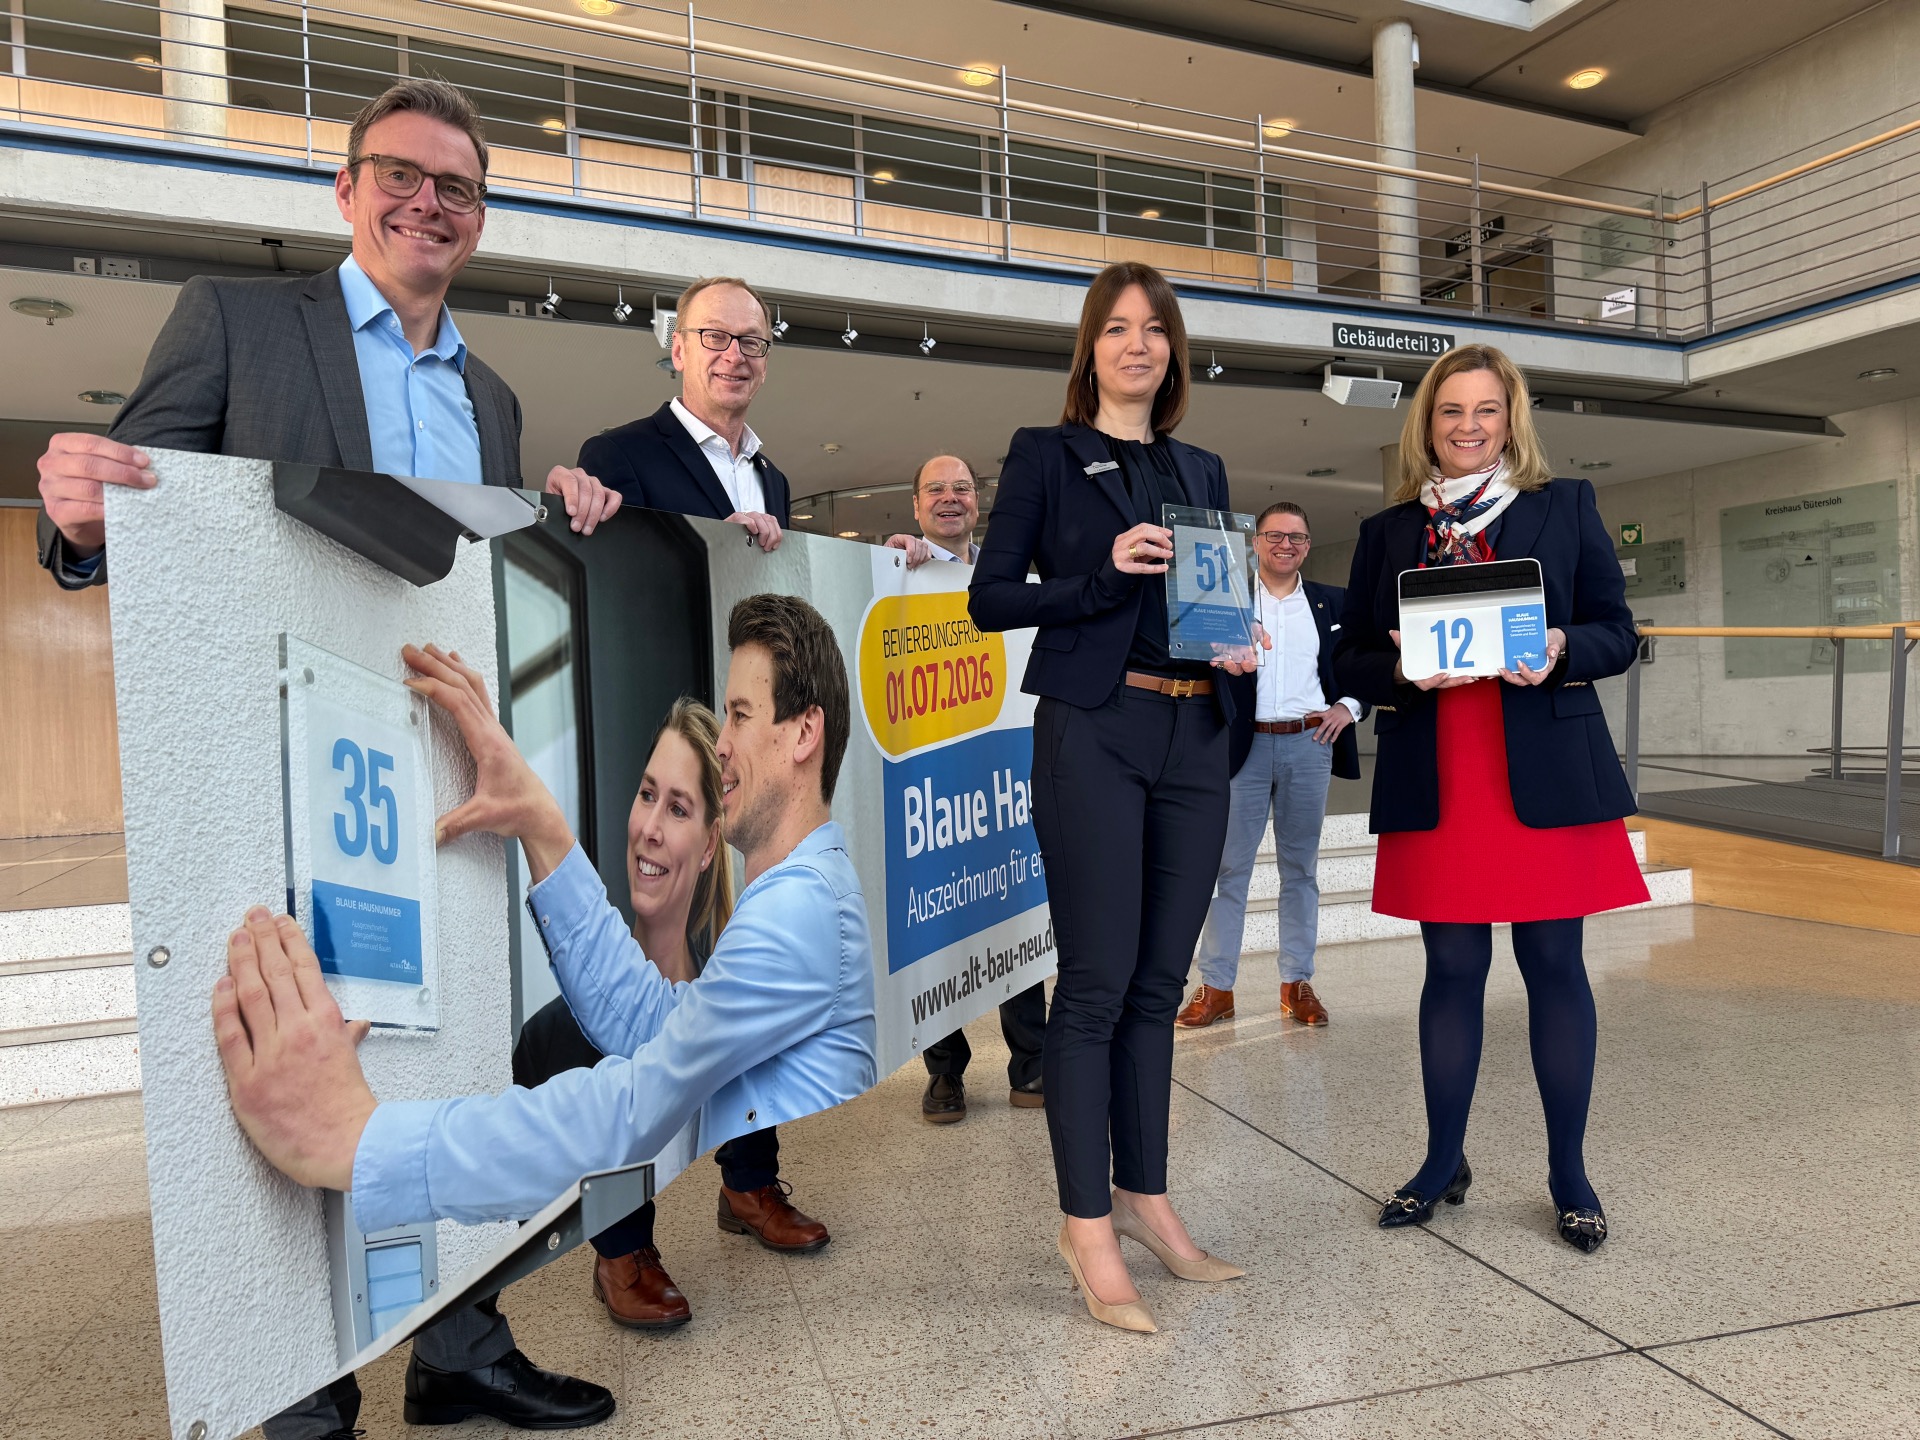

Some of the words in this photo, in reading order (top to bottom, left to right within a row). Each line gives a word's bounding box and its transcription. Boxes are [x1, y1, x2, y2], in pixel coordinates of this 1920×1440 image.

[1337, 327, 1429, 352] Gebäudeteil
[1431, 337, 1440, 353] 3
[1765, 504, 1802, 516] Kreishaus
[1803, 496, 1842, 510] Gütersloh
[1194, 541, 1230, 593] 51
[1779, 568, 1786, 578] 8
[882, 619, 988, 659] BEWERBUNGSFRIS
[1430, 617, 1475, 669] 12
[886, 652, 993, 725] 01.07.2026
[332, 737, 398, 865] 35
[903, 776, 988, 859] Blaue
[335, 896, 357, 909] BLAUE
[358, 901, 402, 918] HAUSNUMMER
[907, 864, 1008, 928] Auszeichnung
[1010, 848, 1028, 886] für
